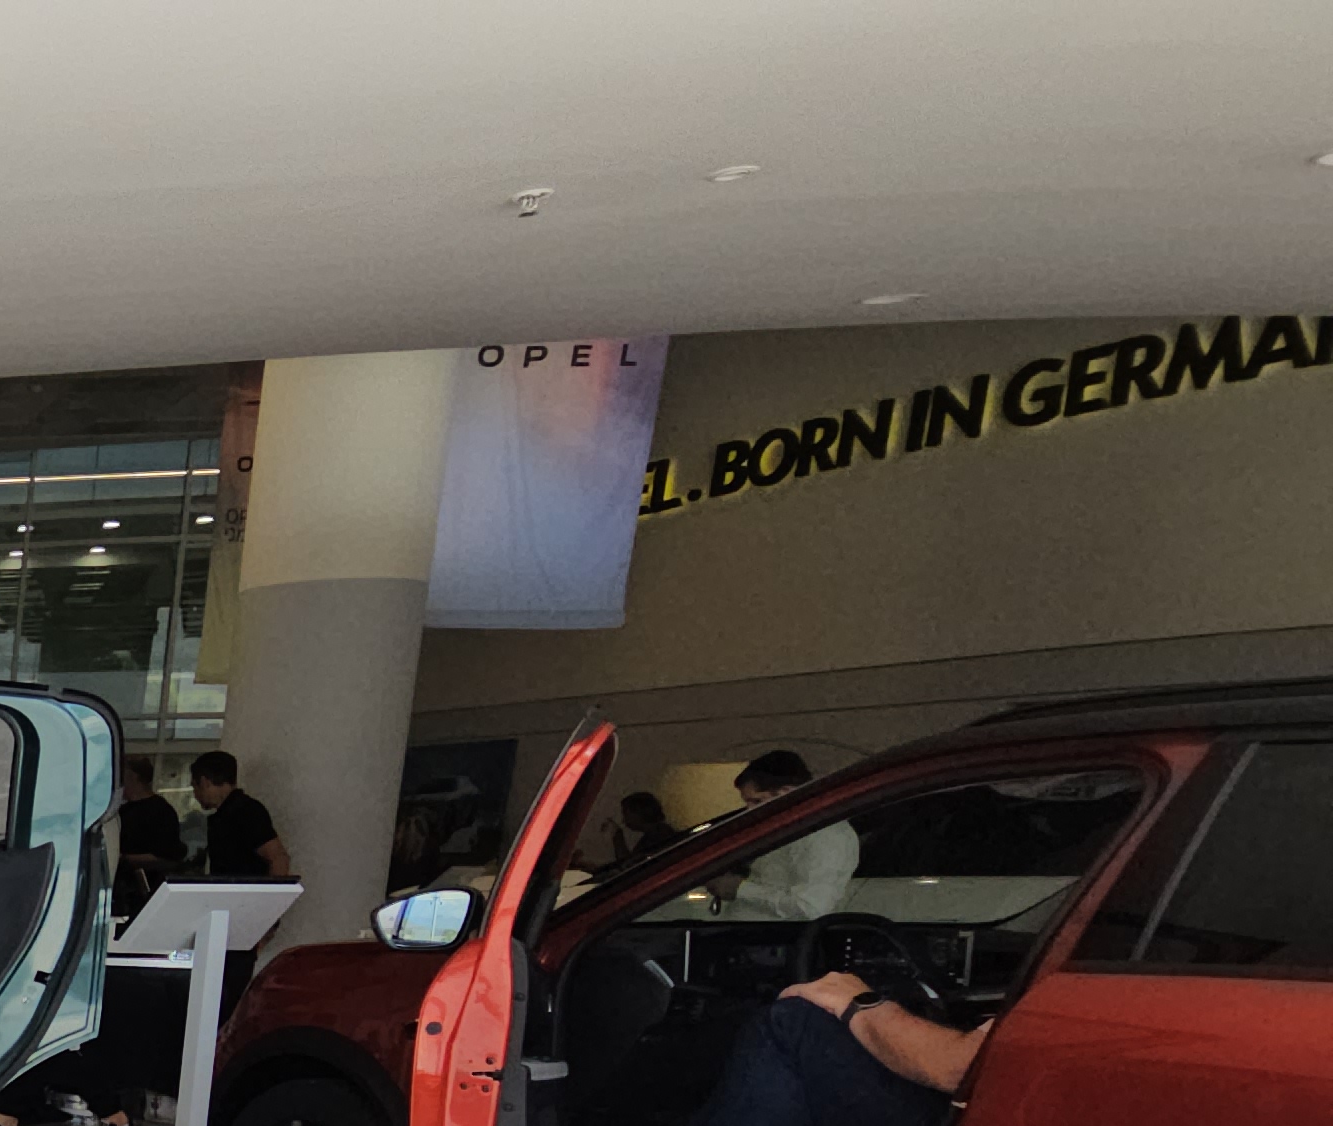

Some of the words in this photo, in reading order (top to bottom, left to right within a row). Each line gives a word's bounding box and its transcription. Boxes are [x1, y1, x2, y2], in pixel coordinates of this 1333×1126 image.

[477, 344, 637, 368] OPEL
[709, 398, 895, 497] BORN
[905, 374, 990, 453] IN
